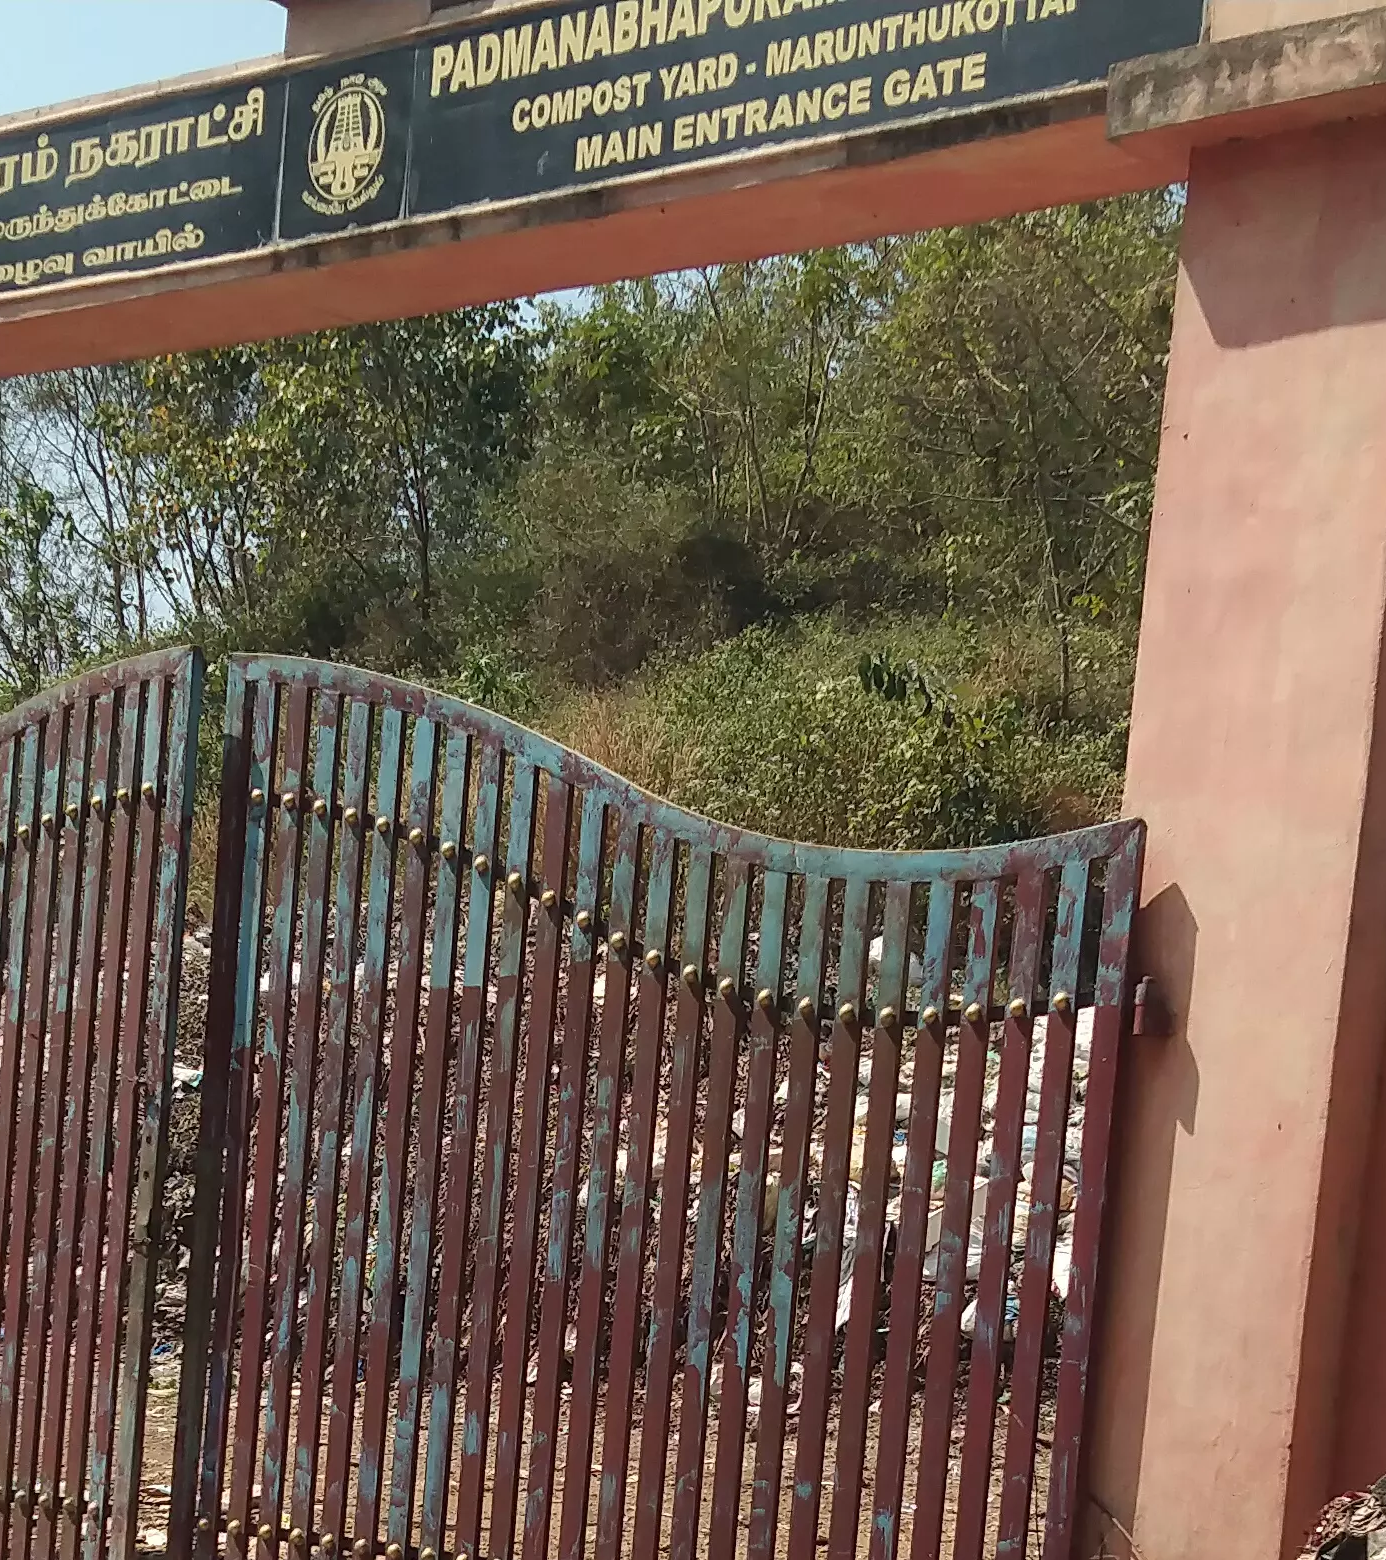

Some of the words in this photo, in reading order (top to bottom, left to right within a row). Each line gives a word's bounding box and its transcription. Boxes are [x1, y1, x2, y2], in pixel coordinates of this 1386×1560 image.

[430, 0, 846, 97] PADMANABHAPU
[512, 71, 651, 133] COMPOST
[659, 52, 739, 101] YARD
[64, 86, 265, 188] நகராட்சி
[574, 121, 663, 173] MAIN
[673, 76, 873, 151] ENTRANCE
[883, 52, 987, 108] GATE
[82, 222, 205, 268] வாயில்
